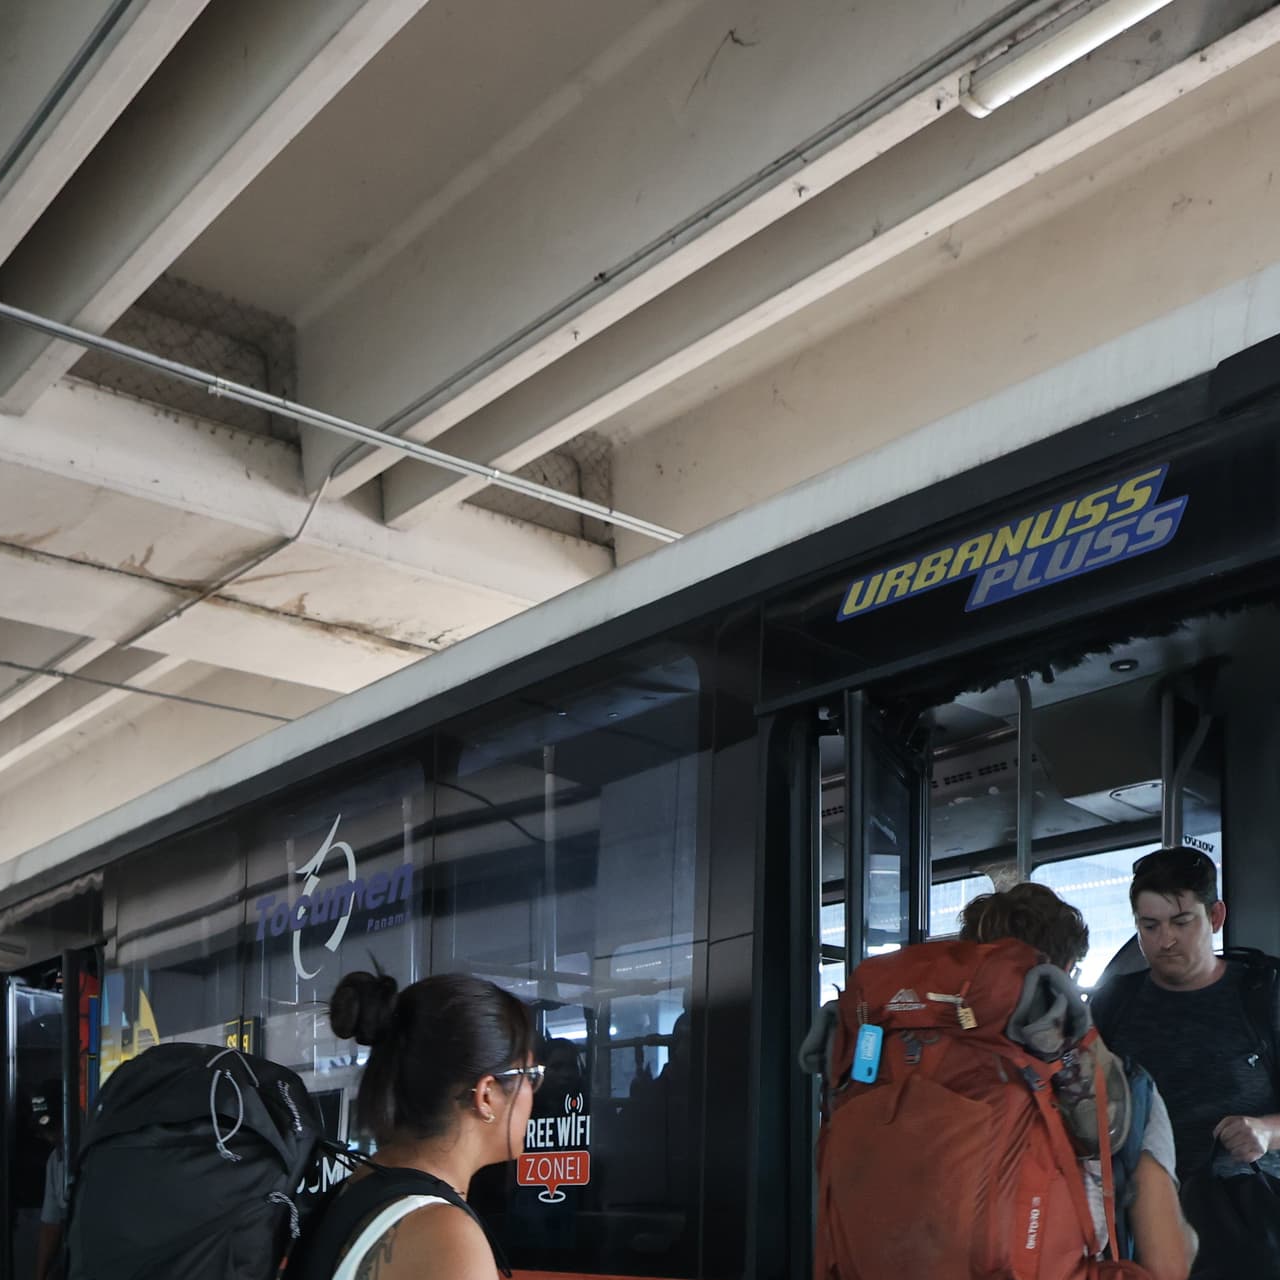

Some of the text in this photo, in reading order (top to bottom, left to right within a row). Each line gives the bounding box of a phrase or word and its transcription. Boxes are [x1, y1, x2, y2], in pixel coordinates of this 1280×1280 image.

[841, 467, 1163, 616] URBANUSS
[971, 498, 1183, 606] PLUSS
[255, 863, 415, 941] Tocumen
[525, 1156, 581, 1181] ZONE!
[526, 1117, 553, 1148] REE
